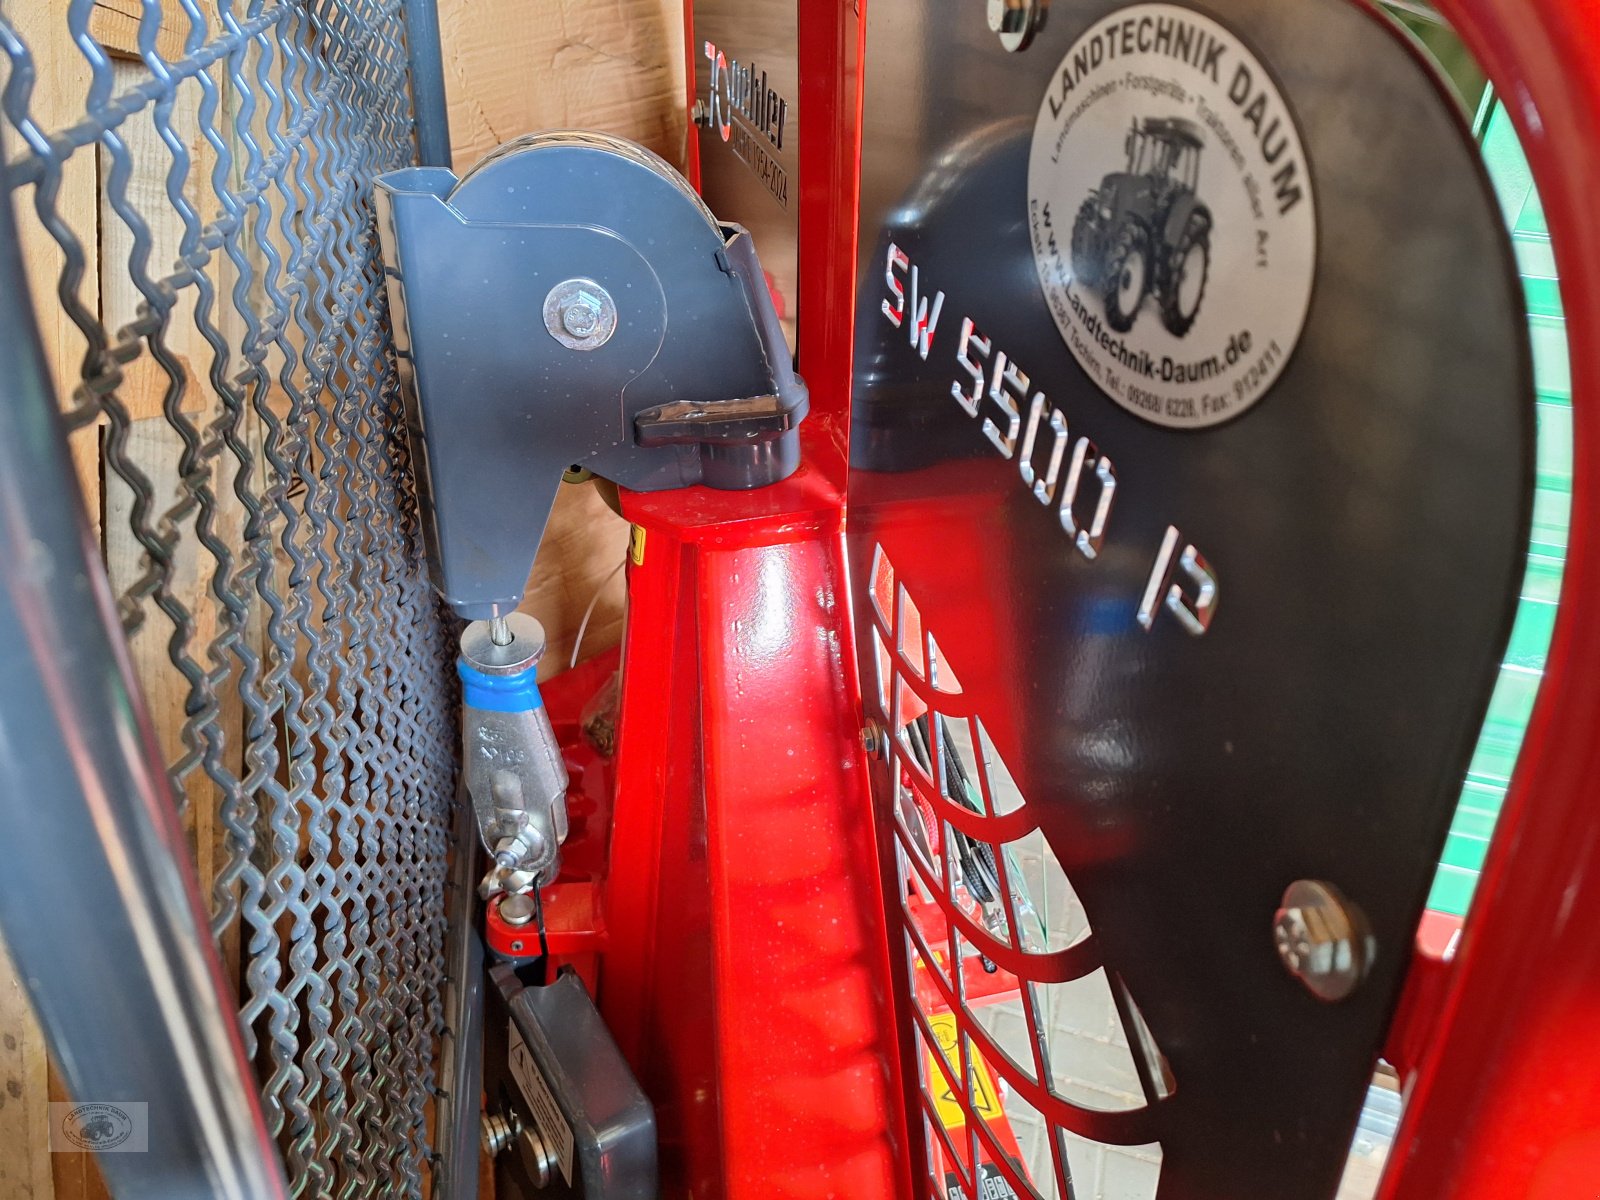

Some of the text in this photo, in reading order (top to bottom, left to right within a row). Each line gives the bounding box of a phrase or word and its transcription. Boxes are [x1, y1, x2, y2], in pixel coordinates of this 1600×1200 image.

[1048, 14, 1303, 215] LANDTECHNIK DAUM
[1255, 228, 1271, 268] Art
[880, 242, 1218, 637] SW 5500 P
